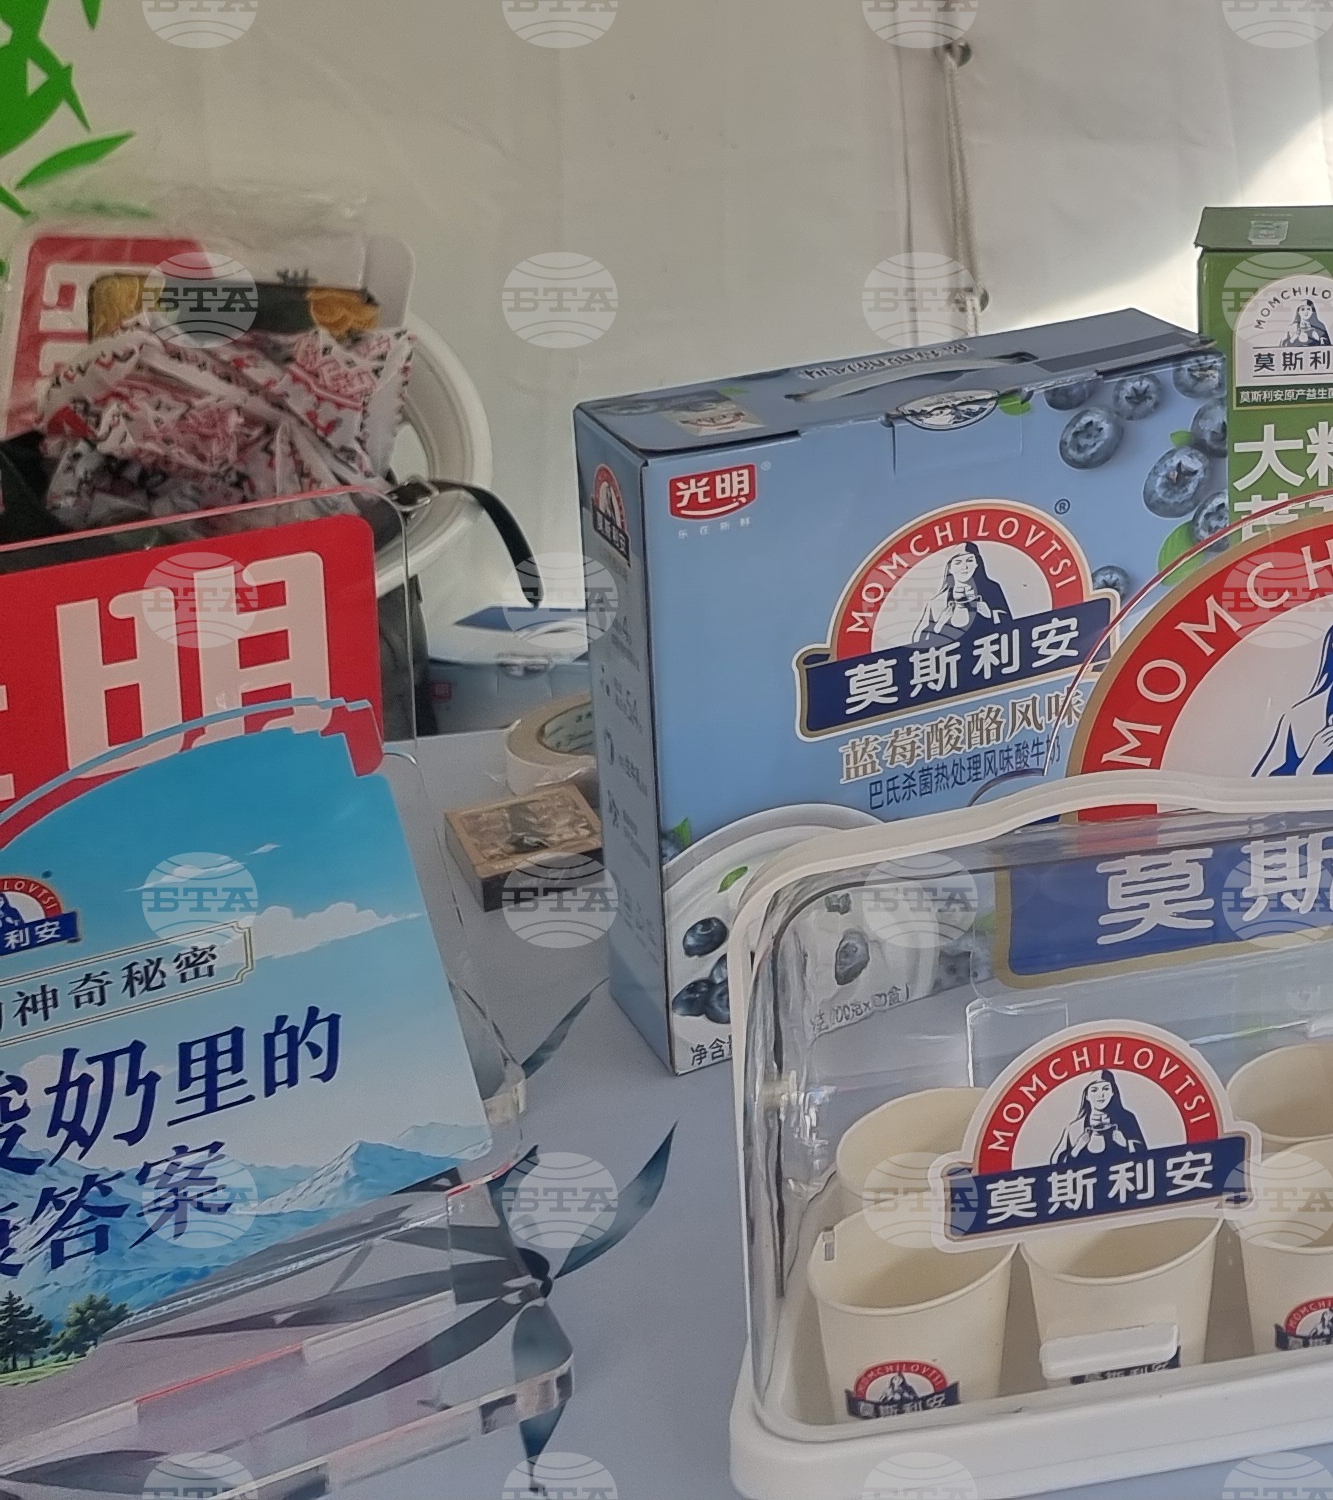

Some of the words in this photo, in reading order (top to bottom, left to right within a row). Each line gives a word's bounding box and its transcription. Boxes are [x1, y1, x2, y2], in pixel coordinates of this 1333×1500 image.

[676, 468, 750, 508] 光明
[845, 515, 1078, 634] MOMCHILOVTSI
[0, 551, 333, 800] 明
[844, 616, 1081, 715] 莫斯利安
[839, 688, 1083, 785] 蓝莓酸酪风味
[868, 737, 1062, 811] 巴氏杀菌热处理风味酸牛奶
[0, 944, 218, 1031] 神奇秘密
[987, 1045, 1212, 1153] MOMCHILOVTSI
[986, 1151, 1215, 1226] 莫斯利安
